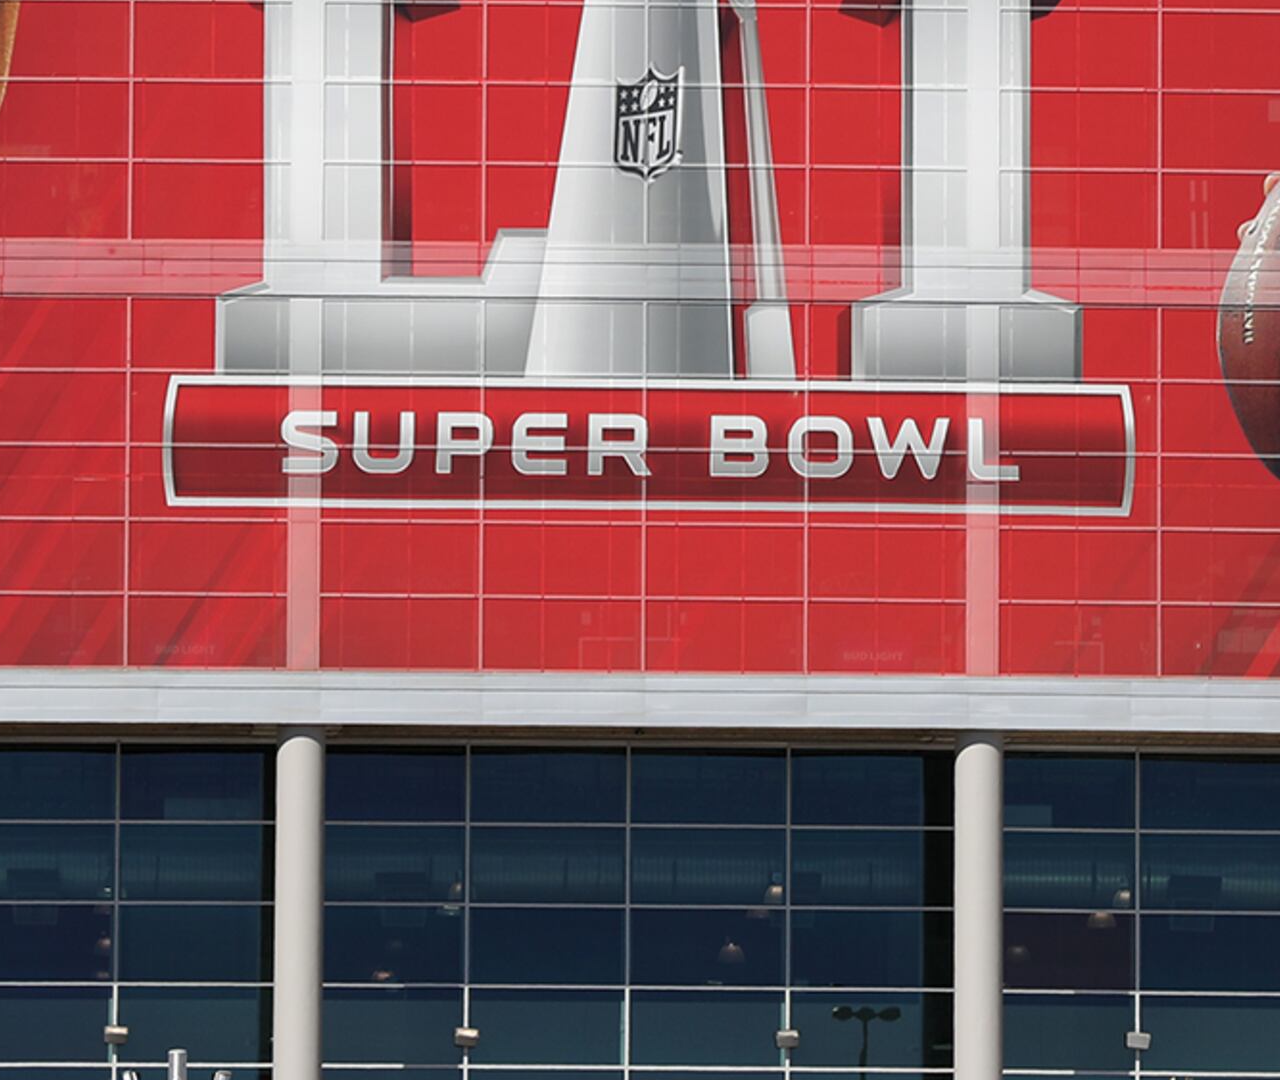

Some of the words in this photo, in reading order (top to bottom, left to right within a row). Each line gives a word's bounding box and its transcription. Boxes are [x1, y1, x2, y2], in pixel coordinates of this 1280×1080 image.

[620, 114, 671, 164] NFL
[280, 410, 652, 476] SUPER
[710, 414, 1020, 481] BOWL
